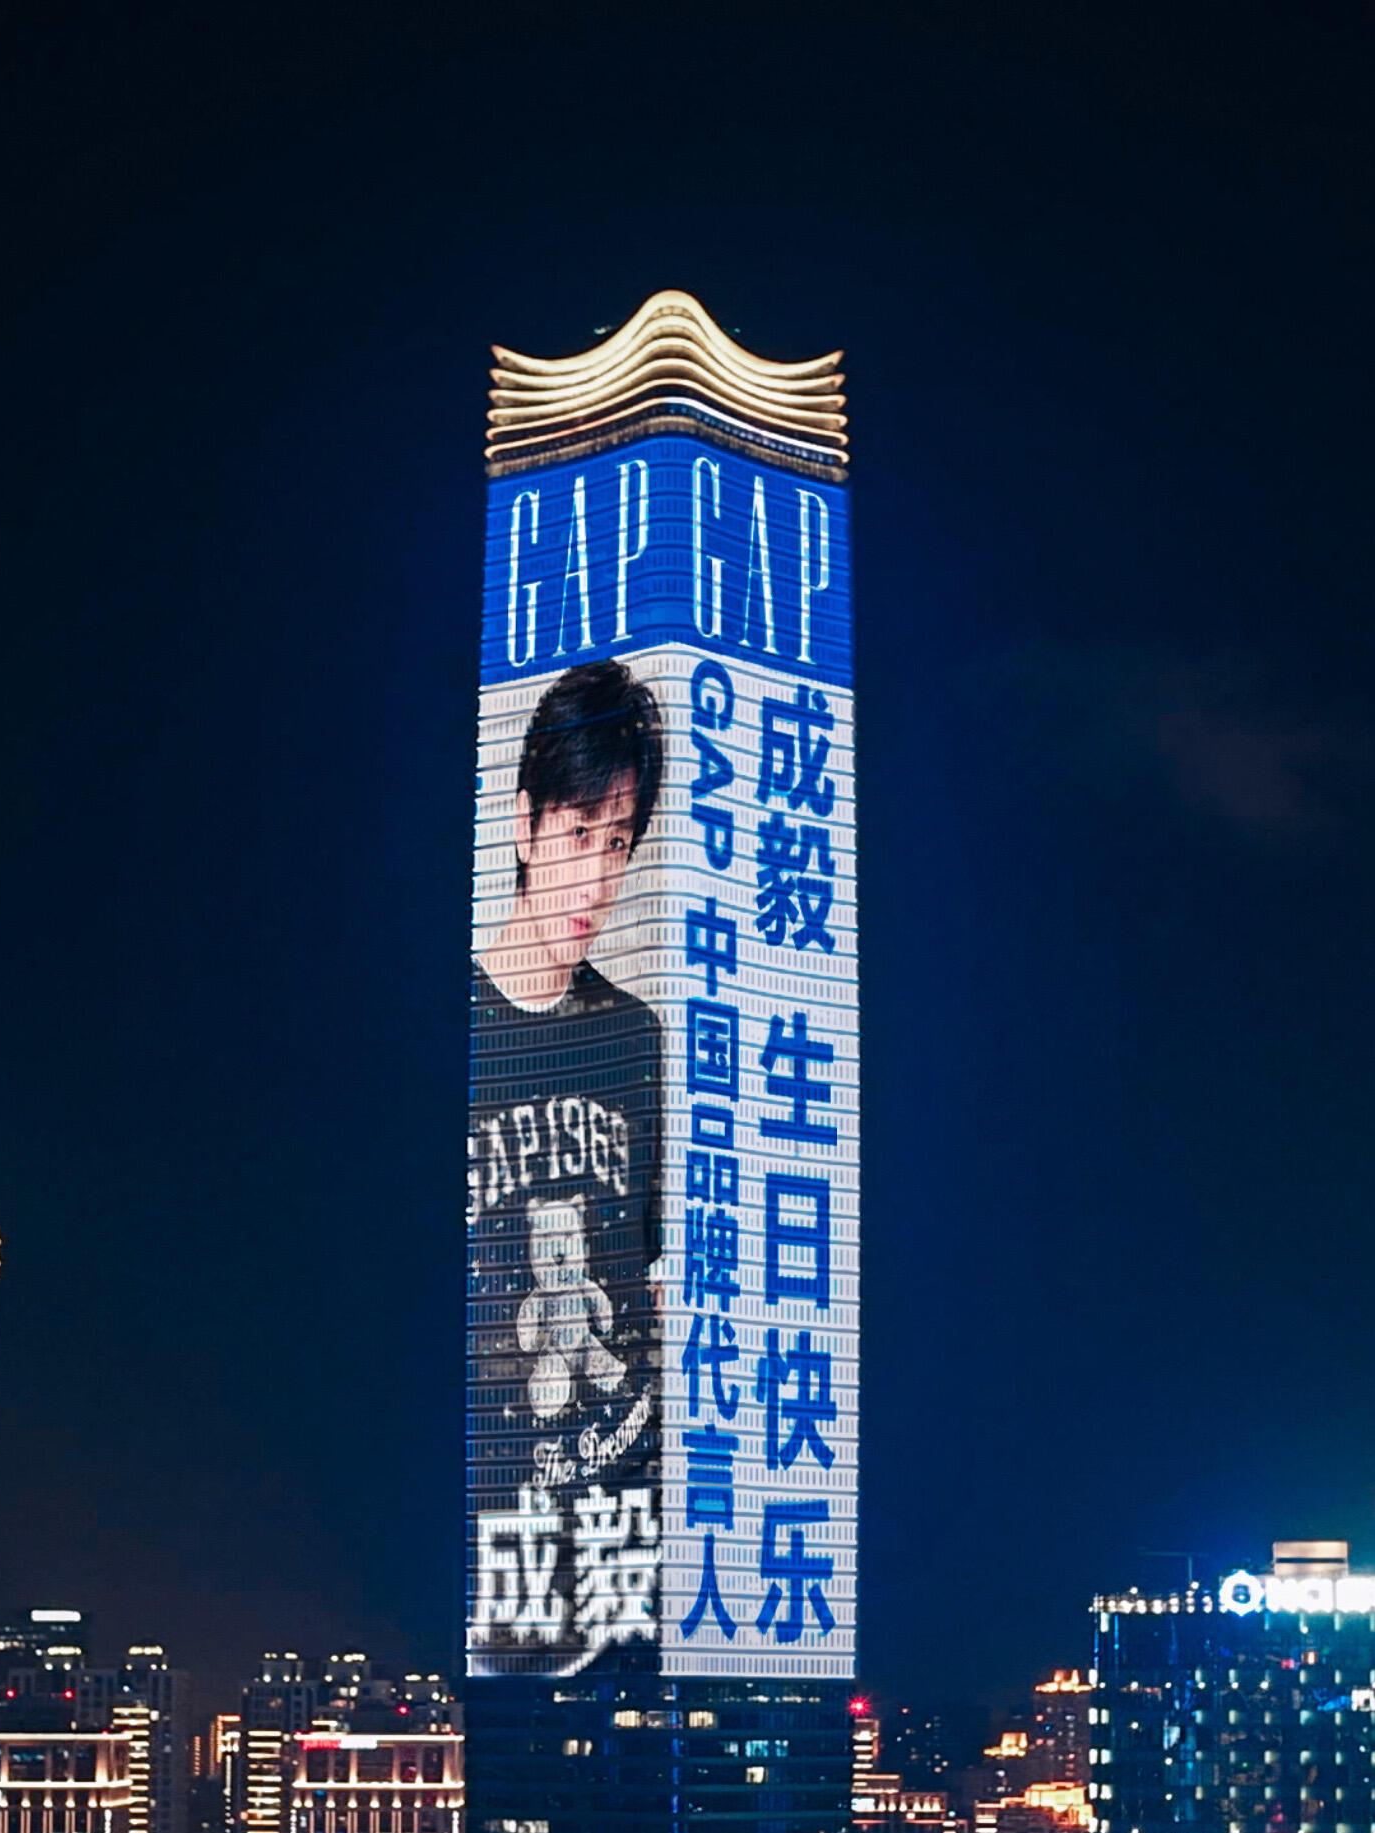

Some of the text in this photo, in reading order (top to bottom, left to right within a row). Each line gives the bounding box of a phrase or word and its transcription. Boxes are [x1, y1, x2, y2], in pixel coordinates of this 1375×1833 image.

[507, 459, 650, 667] GAP
[692, 457, 830, 665] GAP
[680, 659, 742, 1641] GAP 中国品牌代言人
[756, 683, 838, 1643] 成毅 生日快乐
[472, 1482, 659, 1645] 成毅
